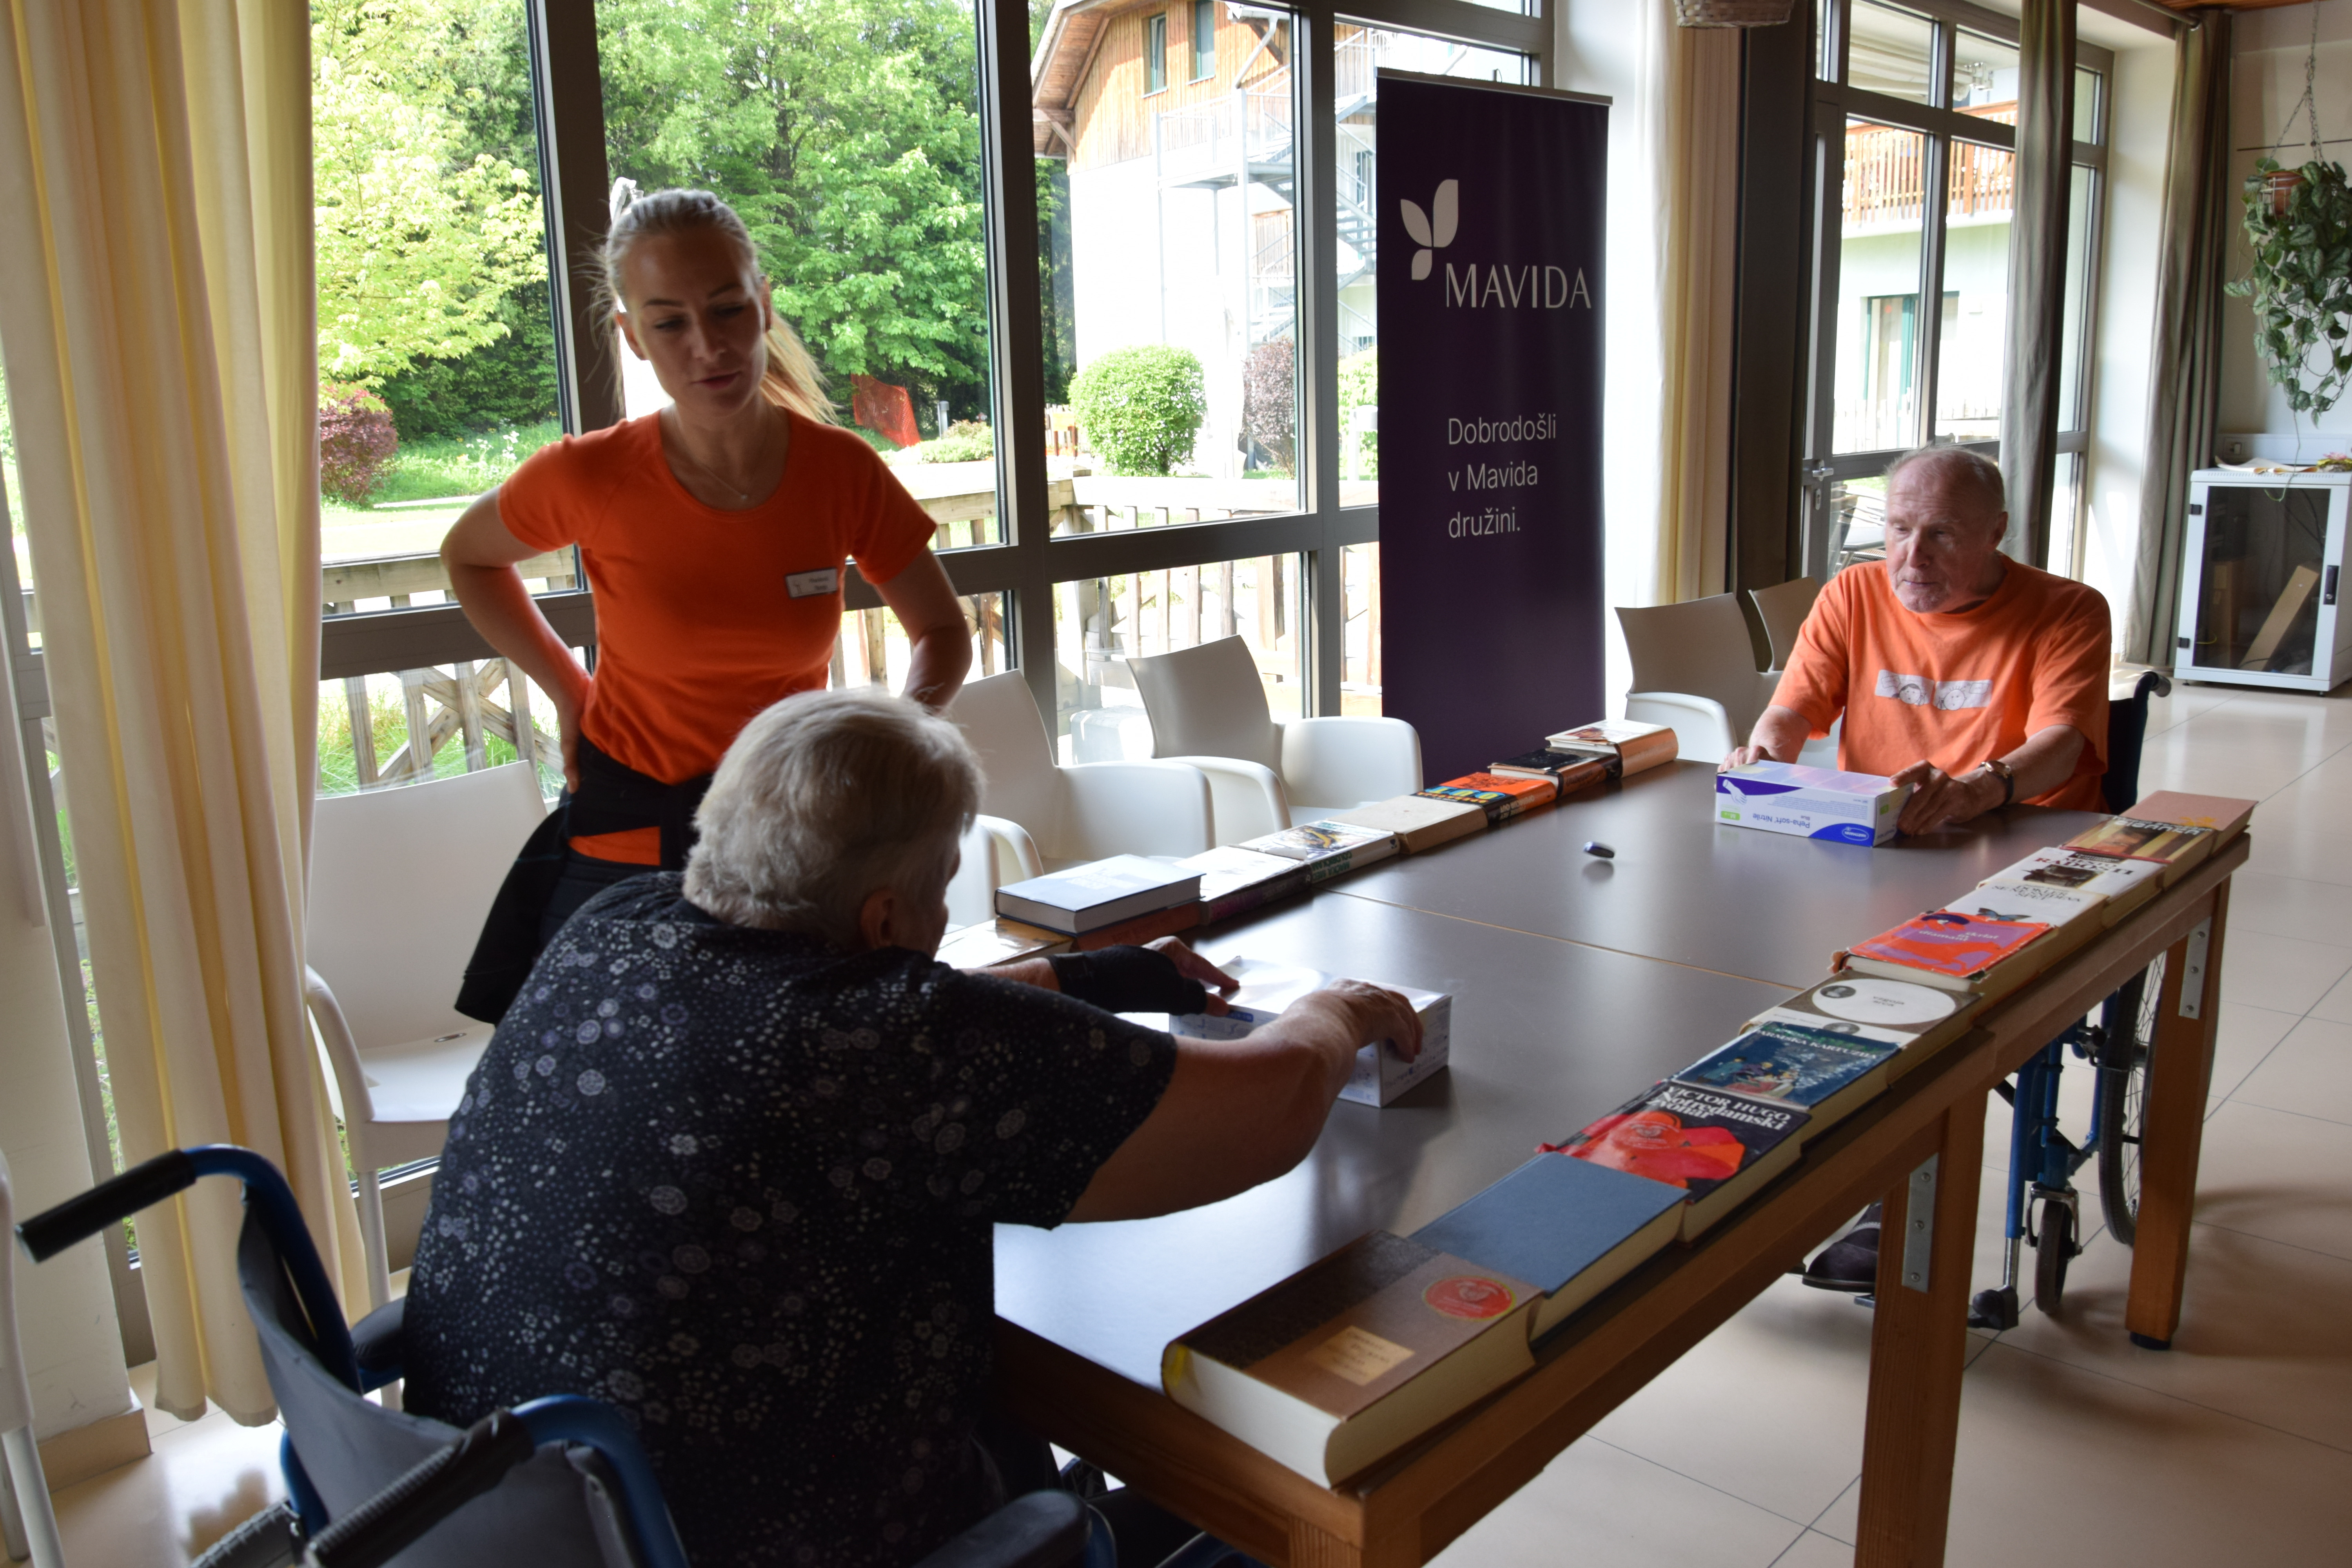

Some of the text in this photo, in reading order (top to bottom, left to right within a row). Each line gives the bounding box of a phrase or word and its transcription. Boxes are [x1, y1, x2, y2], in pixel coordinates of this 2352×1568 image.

[1446, 263, 1592, 309] MAVIDA
[1448, 412, 1556, 445] Dobrodošli
[1448, 460, 1538, 492] v Mavida
[1448, 506, 1521, 538] družini.
[1753, 813, 1773, 822] Nitrile
[2034, 858, 2134, 875] RADOSTI
[1662, 1091, 1788, 1131] Notredamski
[1668, 1086, 1791, 1121] VICTOR HUGO
